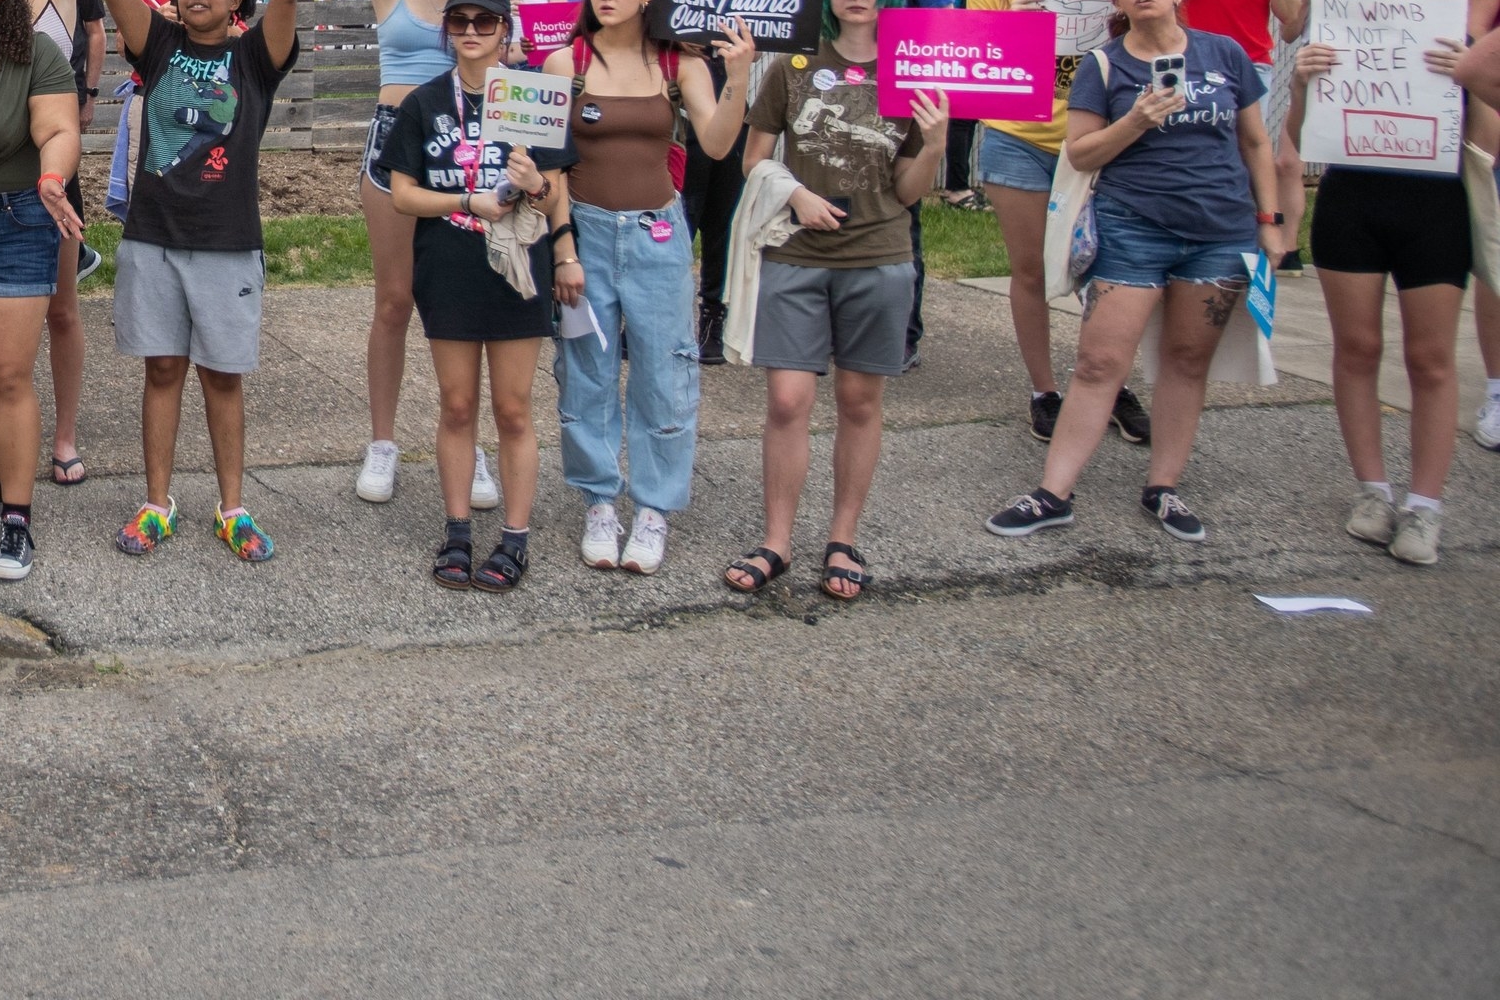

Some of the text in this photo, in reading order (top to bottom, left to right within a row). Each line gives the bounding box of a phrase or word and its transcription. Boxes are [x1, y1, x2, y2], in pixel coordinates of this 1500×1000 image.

[670, 4, 705, 29] Our
[1359, 1, 1425, 22] WOMB
[1318, 24, 1418, 45] IS NOT A
[895, 40, 1003, 60] Abortion is
[895, 60, 966, 78] Health
[972, 62, 1033, 81] Care.
[1316, 77, 1412, 107] ROOM!
[486, 109, 565, 128] LOVE IS LOVE
[1374, 119, 1398, 135] NO
[1441, 109, 1461, 154] Protect
[426, 127, 462, 158] OUR
[1347, 136, 1431, 154] VACANCY!
